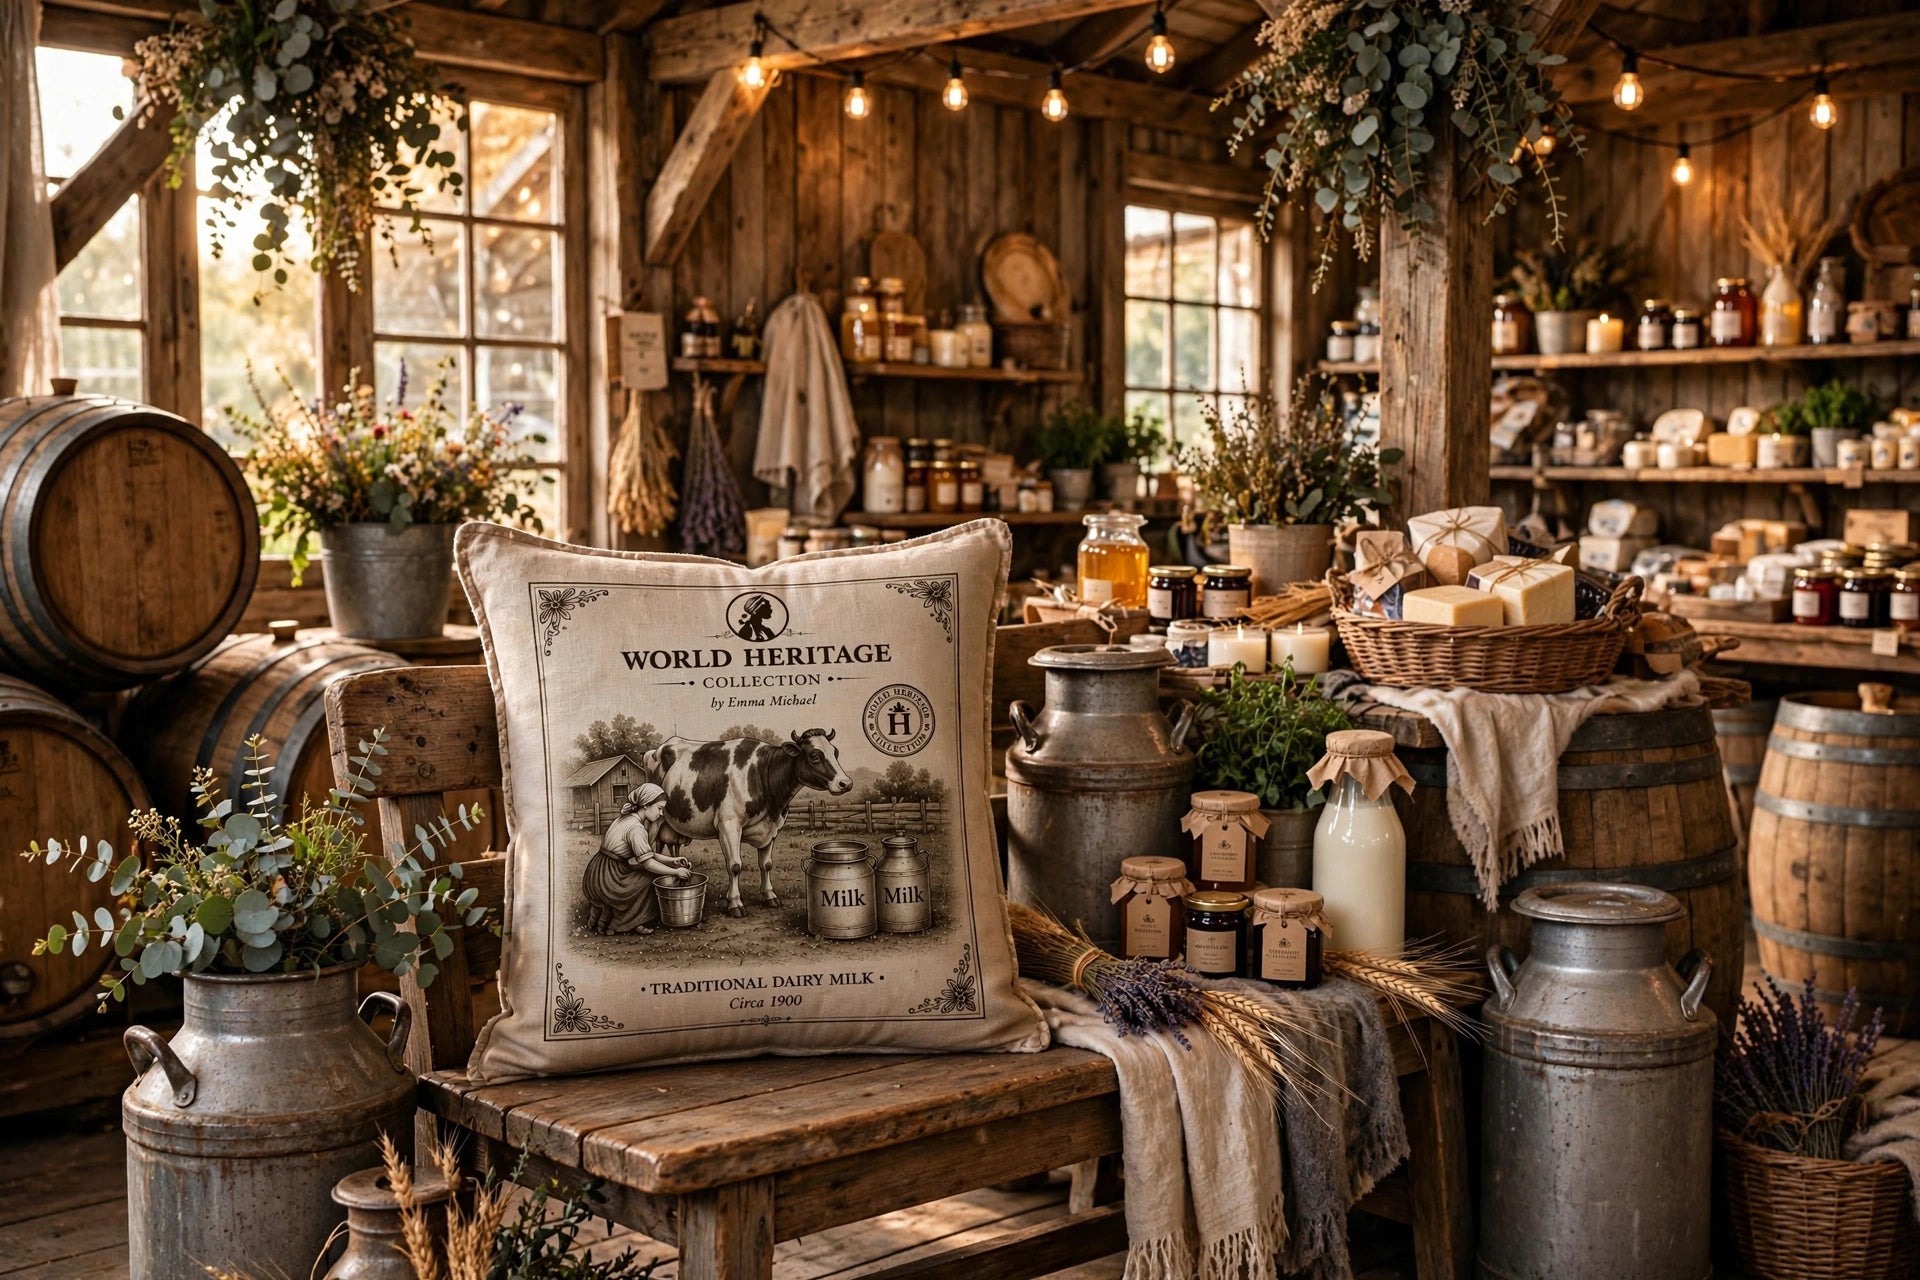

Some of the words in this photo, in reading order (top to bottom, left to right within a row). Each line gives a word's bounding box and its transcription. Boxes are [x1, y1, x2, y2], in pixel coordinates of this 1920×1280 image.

[621, 649, 732, 671] WORLD
[743, 643, 892, 667] HERITAGE
[702, 674, 821, 689] COLLECTION
[710, 696, 724, 711] by
[728, 696, 765, 708] Emma
[769, 693, 817, 707] Michael
[887, 712, 912, 735] H
[820, 888, 866, 908] Milk
[883, 885, 925, 905] Milk
[650, 976, 768, 995] TRADITIONAL
[772, 973, 824, 989] DAIRY
[829, 971, 875, 986] MILK
[729, 995, 764, 1010] Circa
[770, 994, 803, 1008] 1900
